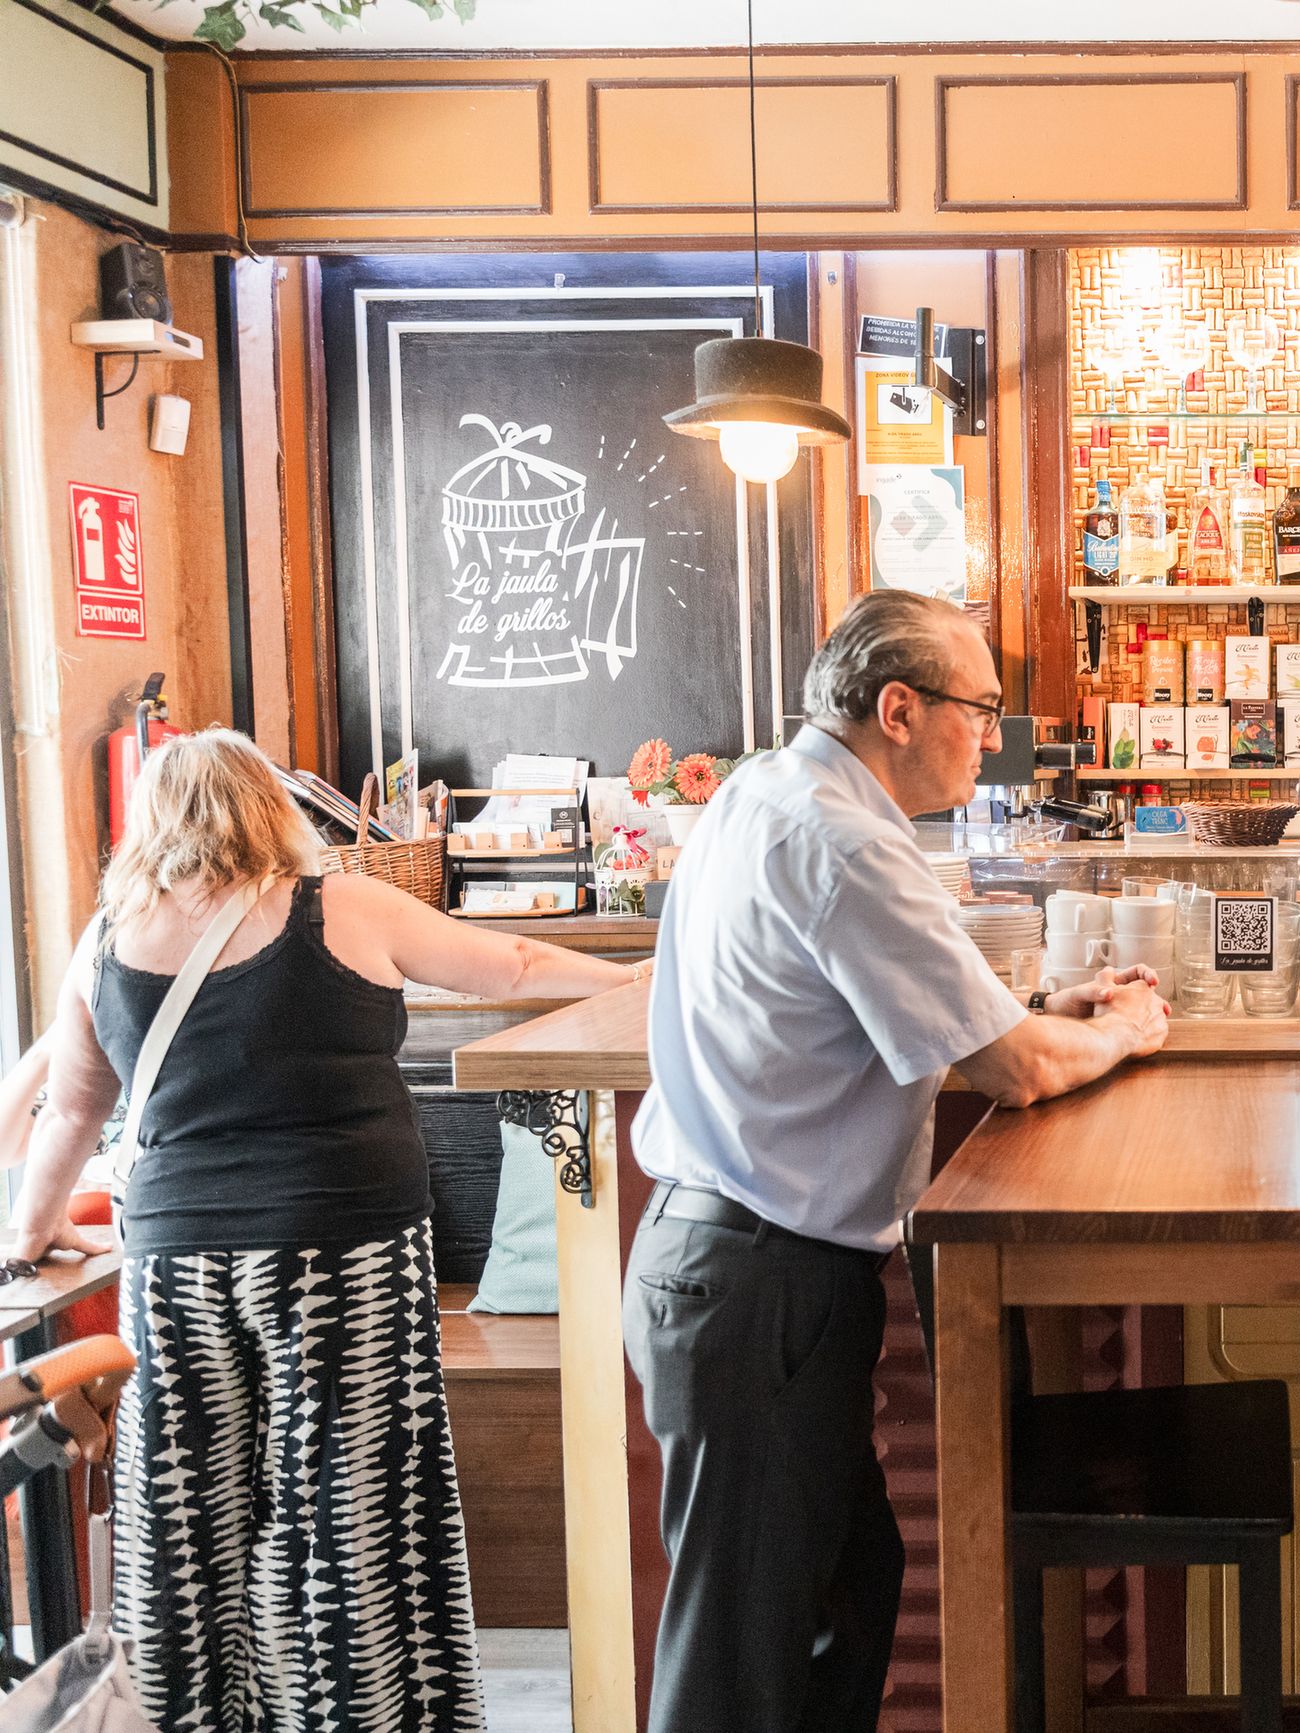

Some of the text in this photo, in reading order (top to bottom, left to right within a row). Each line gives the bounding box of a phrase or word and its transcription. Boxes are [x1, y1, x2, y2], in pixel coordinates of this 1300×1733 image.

[445, 559, 558, 604] La jaula
[81, 603, 140, 625] EXTINTOR
[457, 597, 571, 642] de grillos
